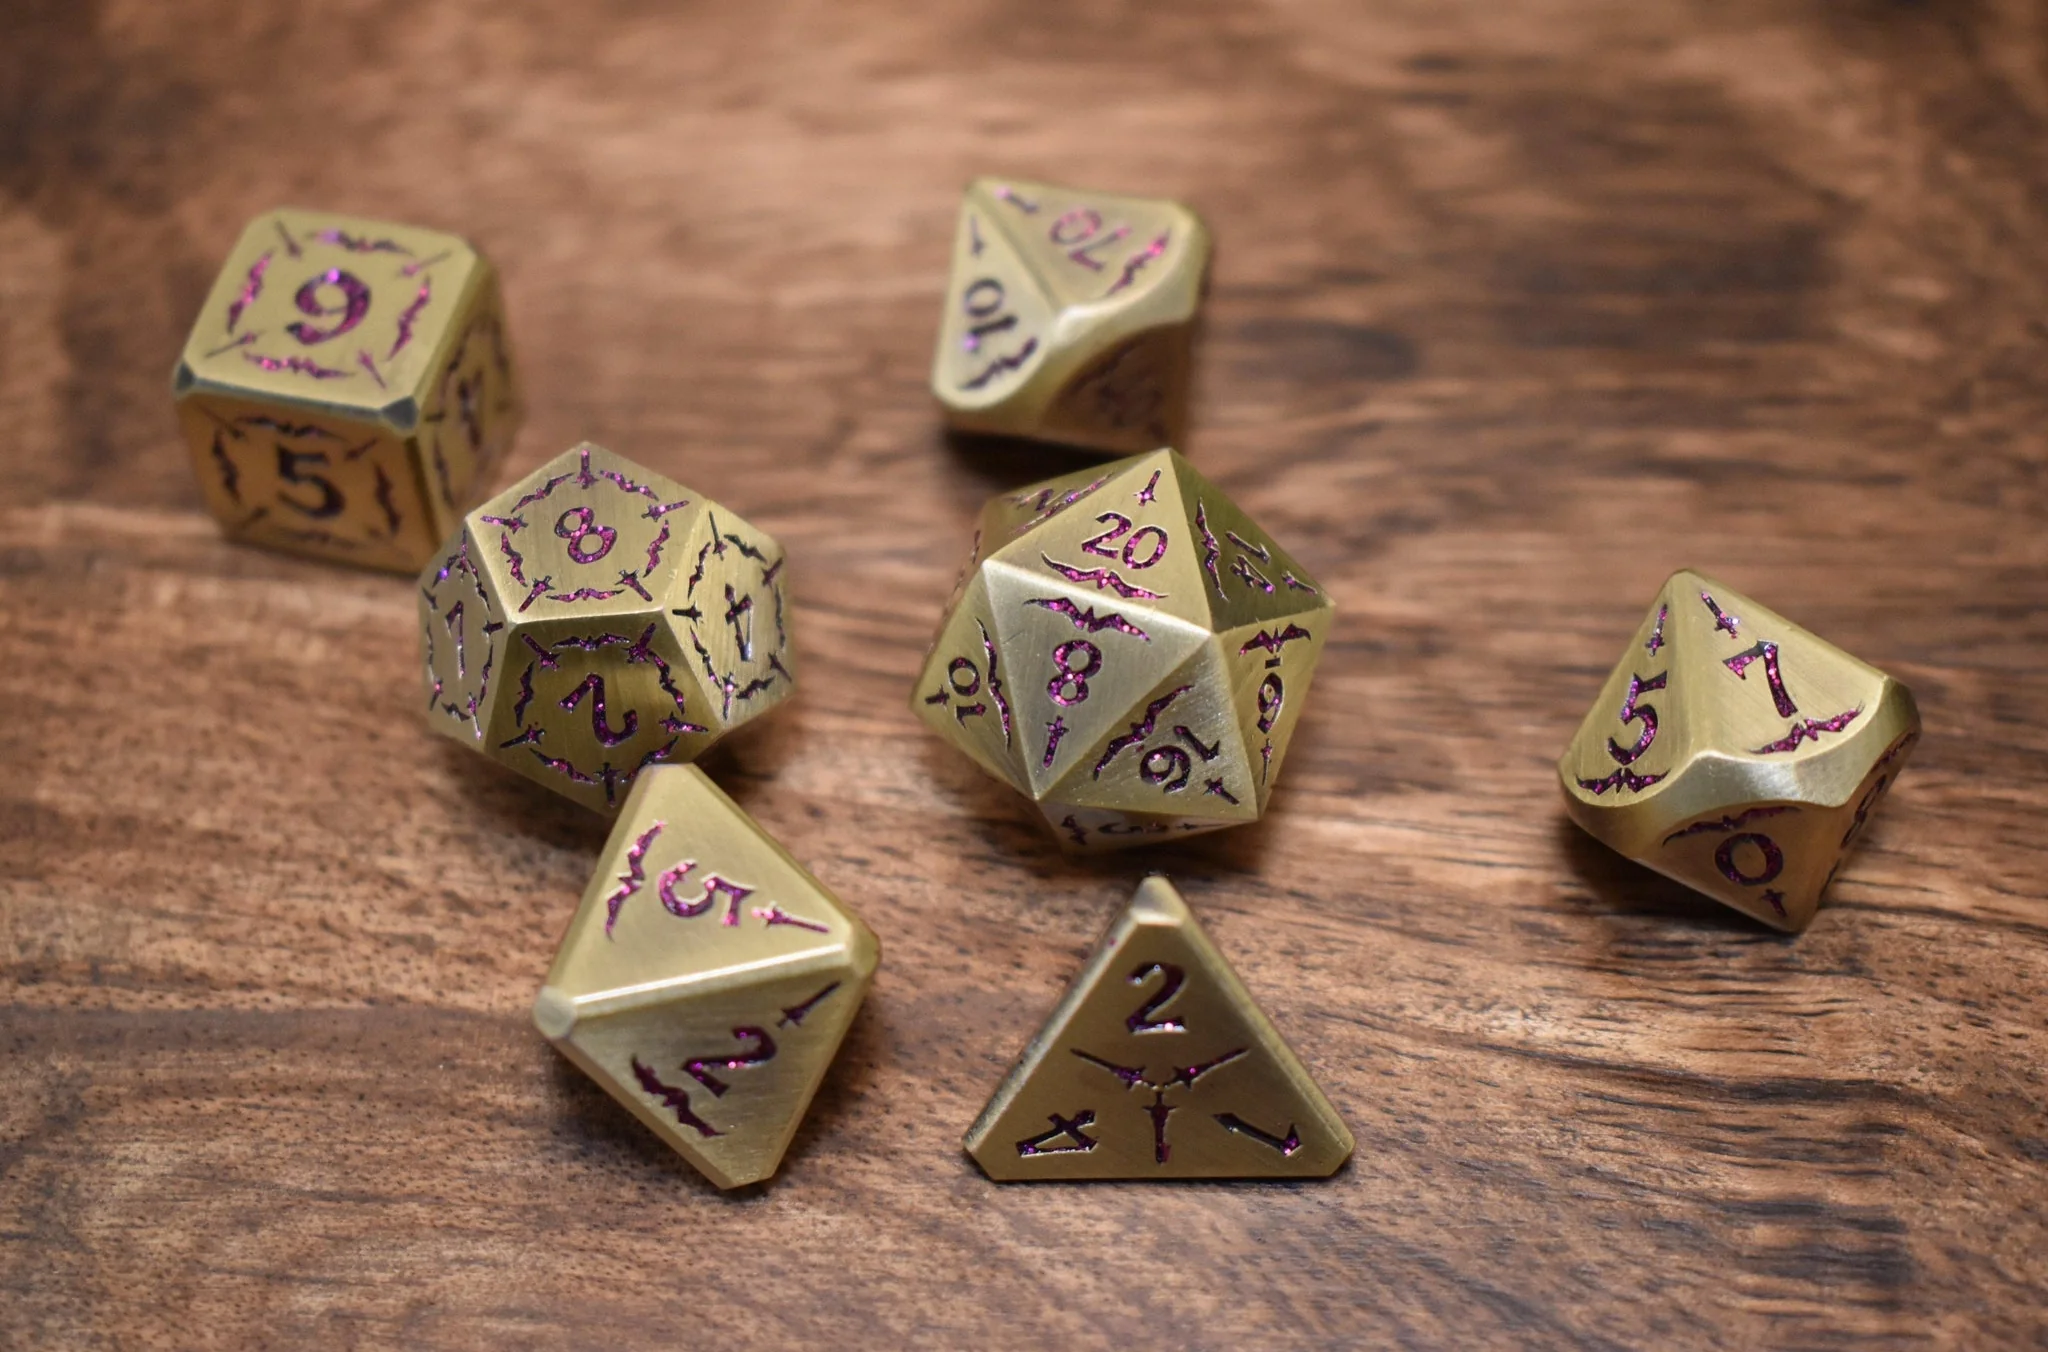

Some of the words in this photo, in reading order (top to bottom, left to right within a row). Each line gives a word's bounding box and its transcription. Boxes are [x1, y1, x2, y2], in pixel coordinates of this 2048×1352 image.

[276, 444, 344, 520] 5
[555, 507, 617, 564] 8
[1081, 511, 1168, 570] 20
[1225, 531, 1275, 594] 14
[445, 600, 466, 678] 1
[725, 584, 753, 661] 4
[947, 657, 986, 729] 10
[1047, 640, 1103, 707] 8
[1722, 640, 1798, 718] 7
[559, 673, 638, 747] 2
[1608, 670, 1668, 766] 5
[1140, 725, 1220, 793] 16
[658, 860, 755, 926] 5
[1715, 833, 1783, 886] 0
[1126, 962, 1187, 1035] 2
[680, 1026, 777, 1098] 2
[1016, 1109, 1098, 1157] 4
[1213, 1111, 1301, 1156] 1
